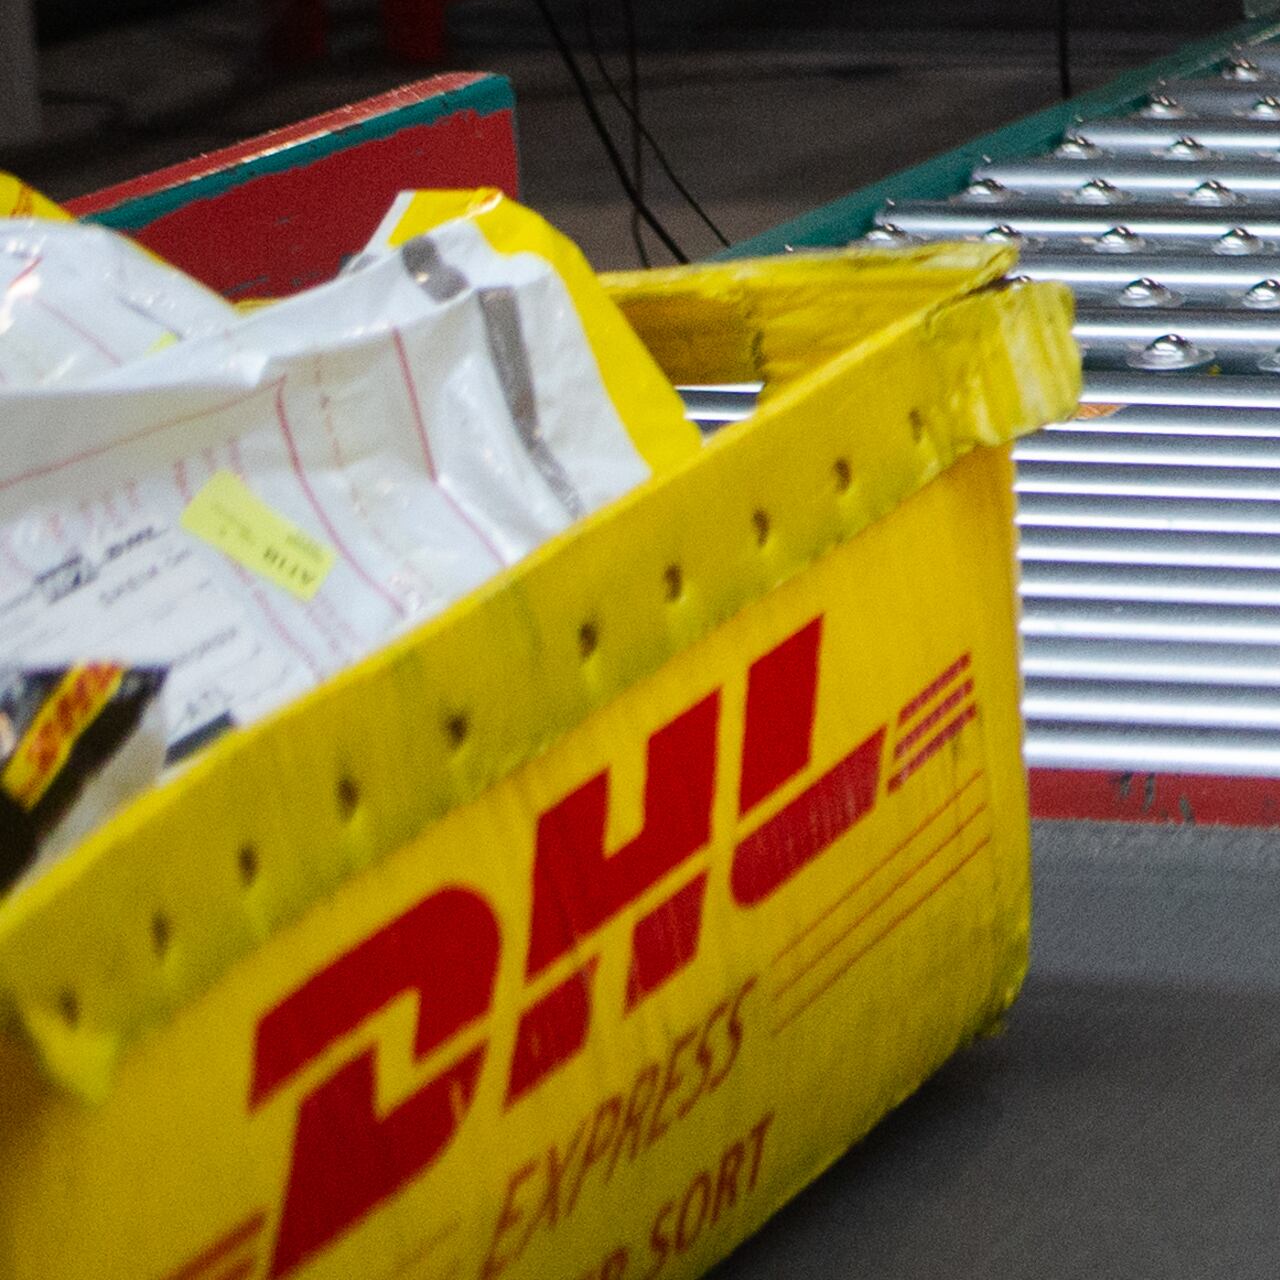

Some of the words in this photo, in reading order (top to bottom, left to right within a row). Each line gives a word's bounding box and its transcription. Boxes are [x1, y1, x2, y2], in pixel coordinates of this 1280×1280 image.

[247, 612, 888, 1280] DHL
[478, 974, 757, 1280] EXPRESS
[647, 1108, 775, 1280] SORT
